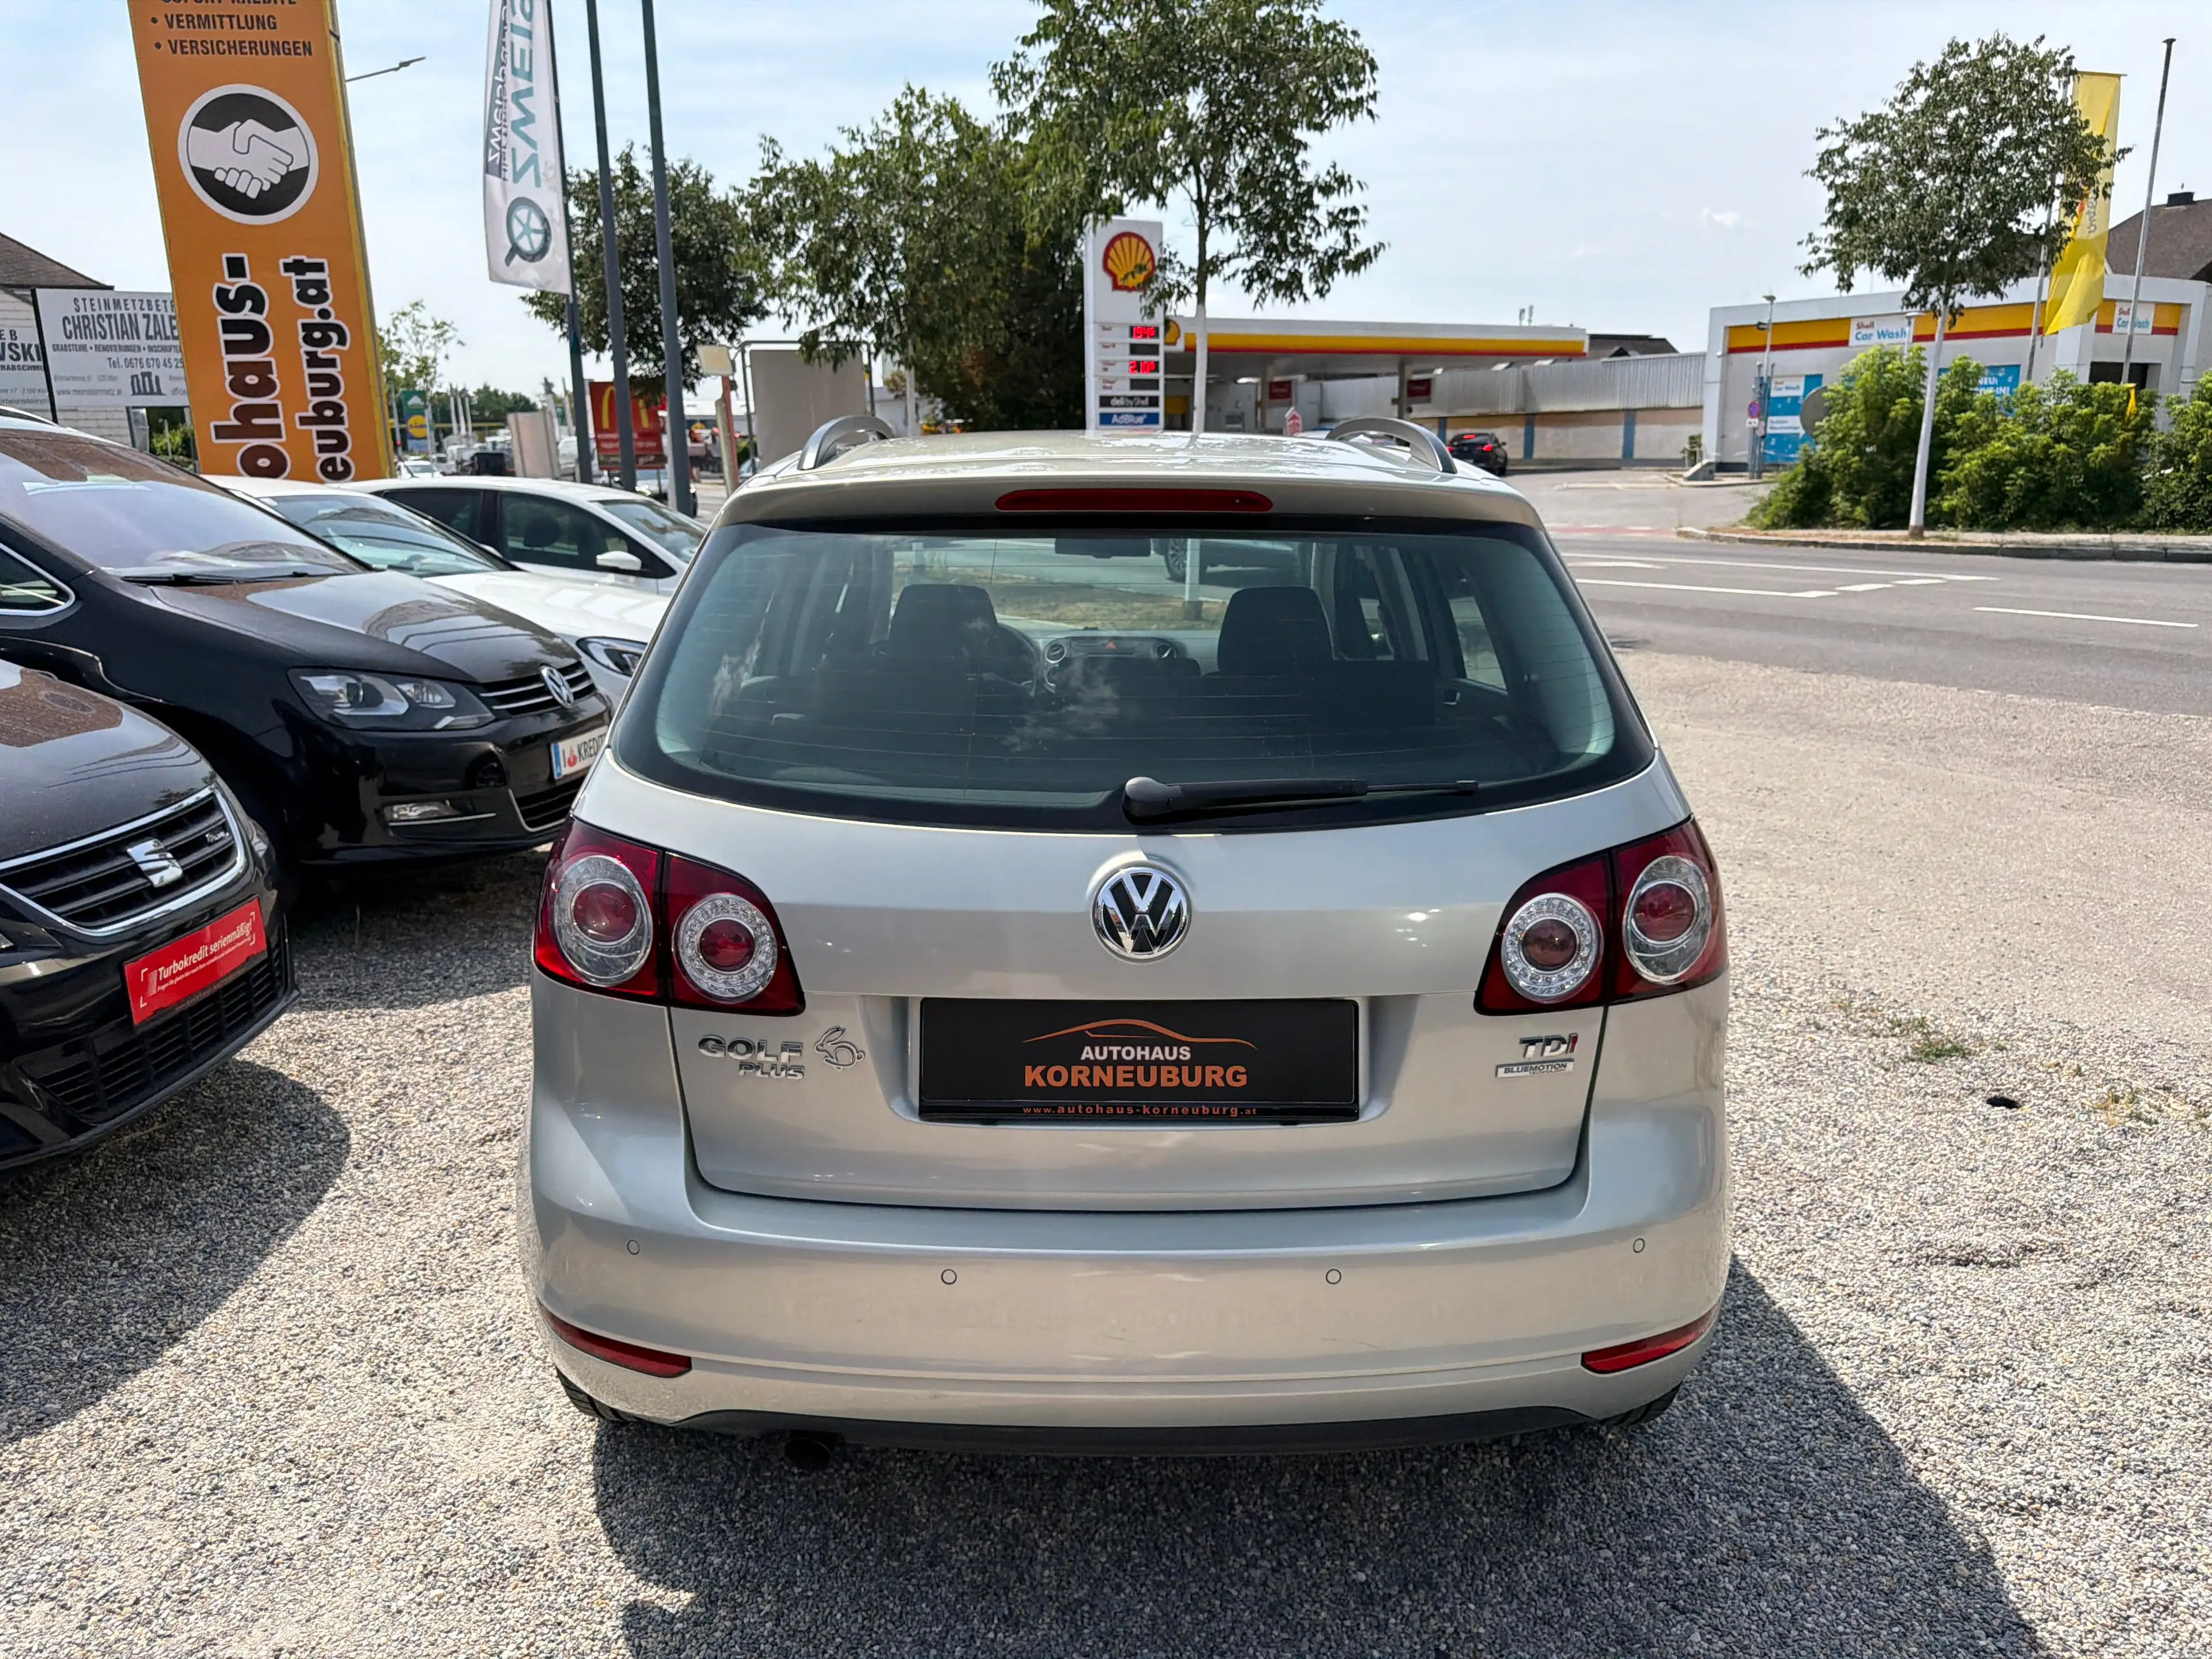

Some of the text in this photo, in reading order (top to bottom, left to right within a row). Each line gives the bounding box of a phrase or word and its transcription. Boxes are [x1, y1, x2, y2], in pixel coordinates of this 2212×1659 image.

[165, 14, 276, 30] VERMITTLUNG
[168, 40, 312, 56] VERSICHERUNGEN
[62, 313, 140, 340] CHRISTIAN
[1856, 321, 1874, 330] Shell
[1855, 327, 1907, 341] Car Wash
[107, 357, 122, 369] Tel.
[146, 358, 161, 369] 670
[163, 358, 173, 369] 45
[282, 257, 353, 482] euburg.at
[158, 945, 209, 982] Turbokredit
[210, 918, 252, 955] serienmäßig!
[698, 1035, 804, 1063] GOLF
[1080, 1046, 1191, 1060] AUTOHAUS
[1520, 1032, 1578, 1058] TDI
[738, 1061, 805, 1080] PLUS
[1025, 1065, 1248, 1087] KORNEUBURG
[1503, 1062, 1567, 1074] BLUEMOTION
[1023, 1104, 1257, 1117] www.autohaus-korneuburg.at
